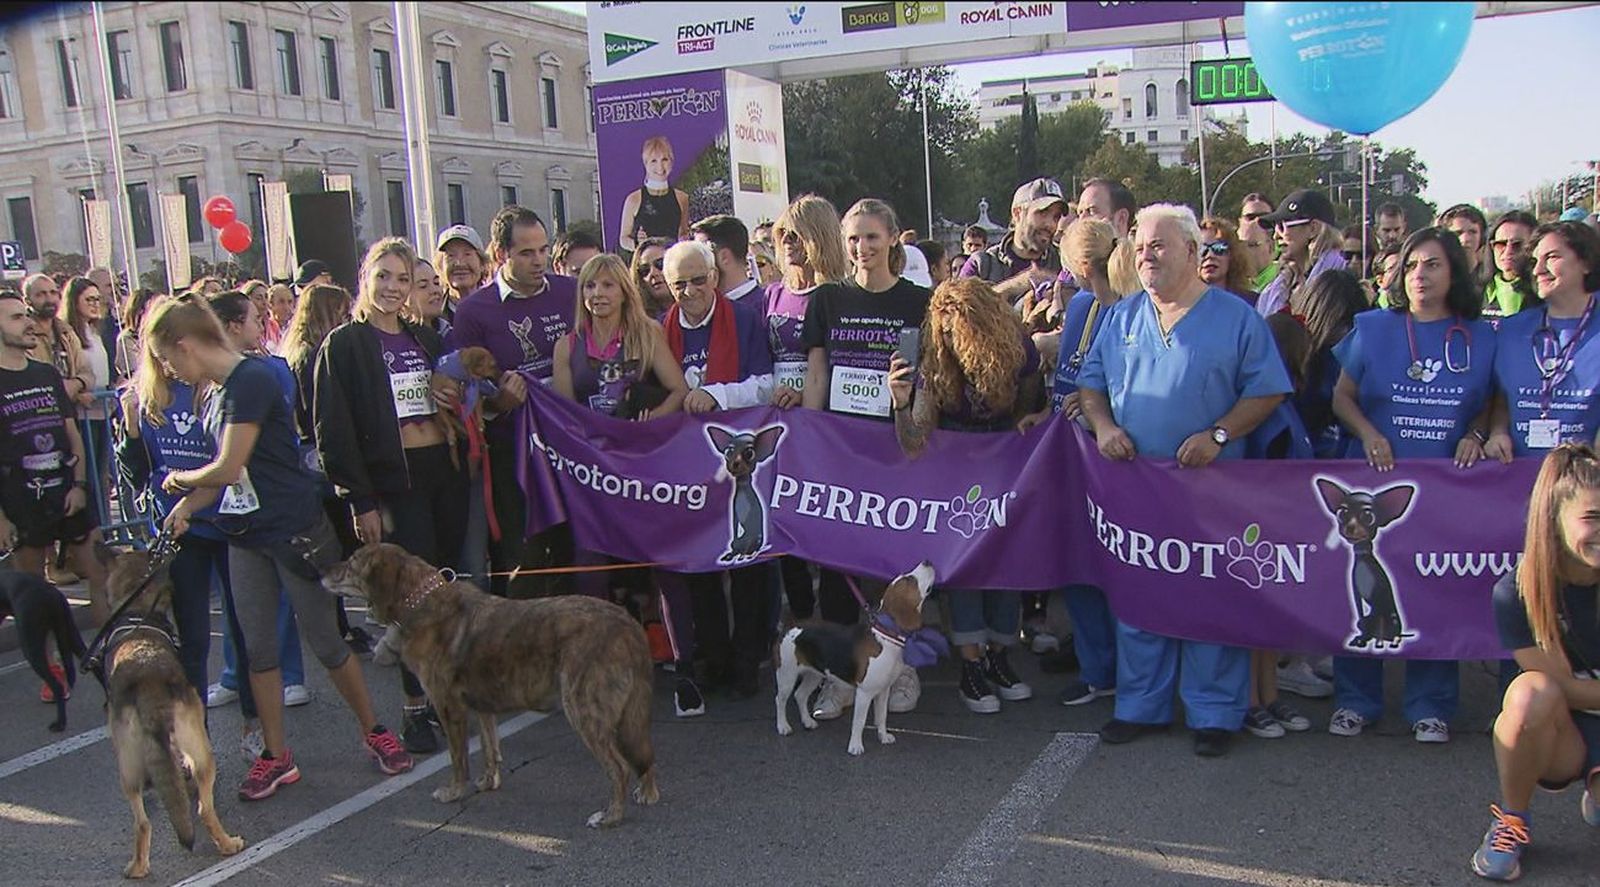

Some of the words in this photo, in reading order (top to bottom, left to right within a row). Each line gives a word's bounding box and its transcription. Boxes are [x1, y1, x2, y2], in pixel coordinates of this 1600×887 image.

[848, 12, 890, 26] Bankia
[960, 9, 1004, 25] ROYAL
[1007, 3, 1053, 20] CANIN
[677, 17, 755, 40] FRONTLINE
[680, 40, 713, 53] TRI-ACT
[2, 244, 15, 266] P
[779, 377, 805, 390] 500
[842, 383, 880, 398] 5000
[1550, 402, 1588, 411] eterinarias
[1391, 416, 1456, 429] VETERINARIOS
[1400, 429, 1447, 441] OFICIALES
